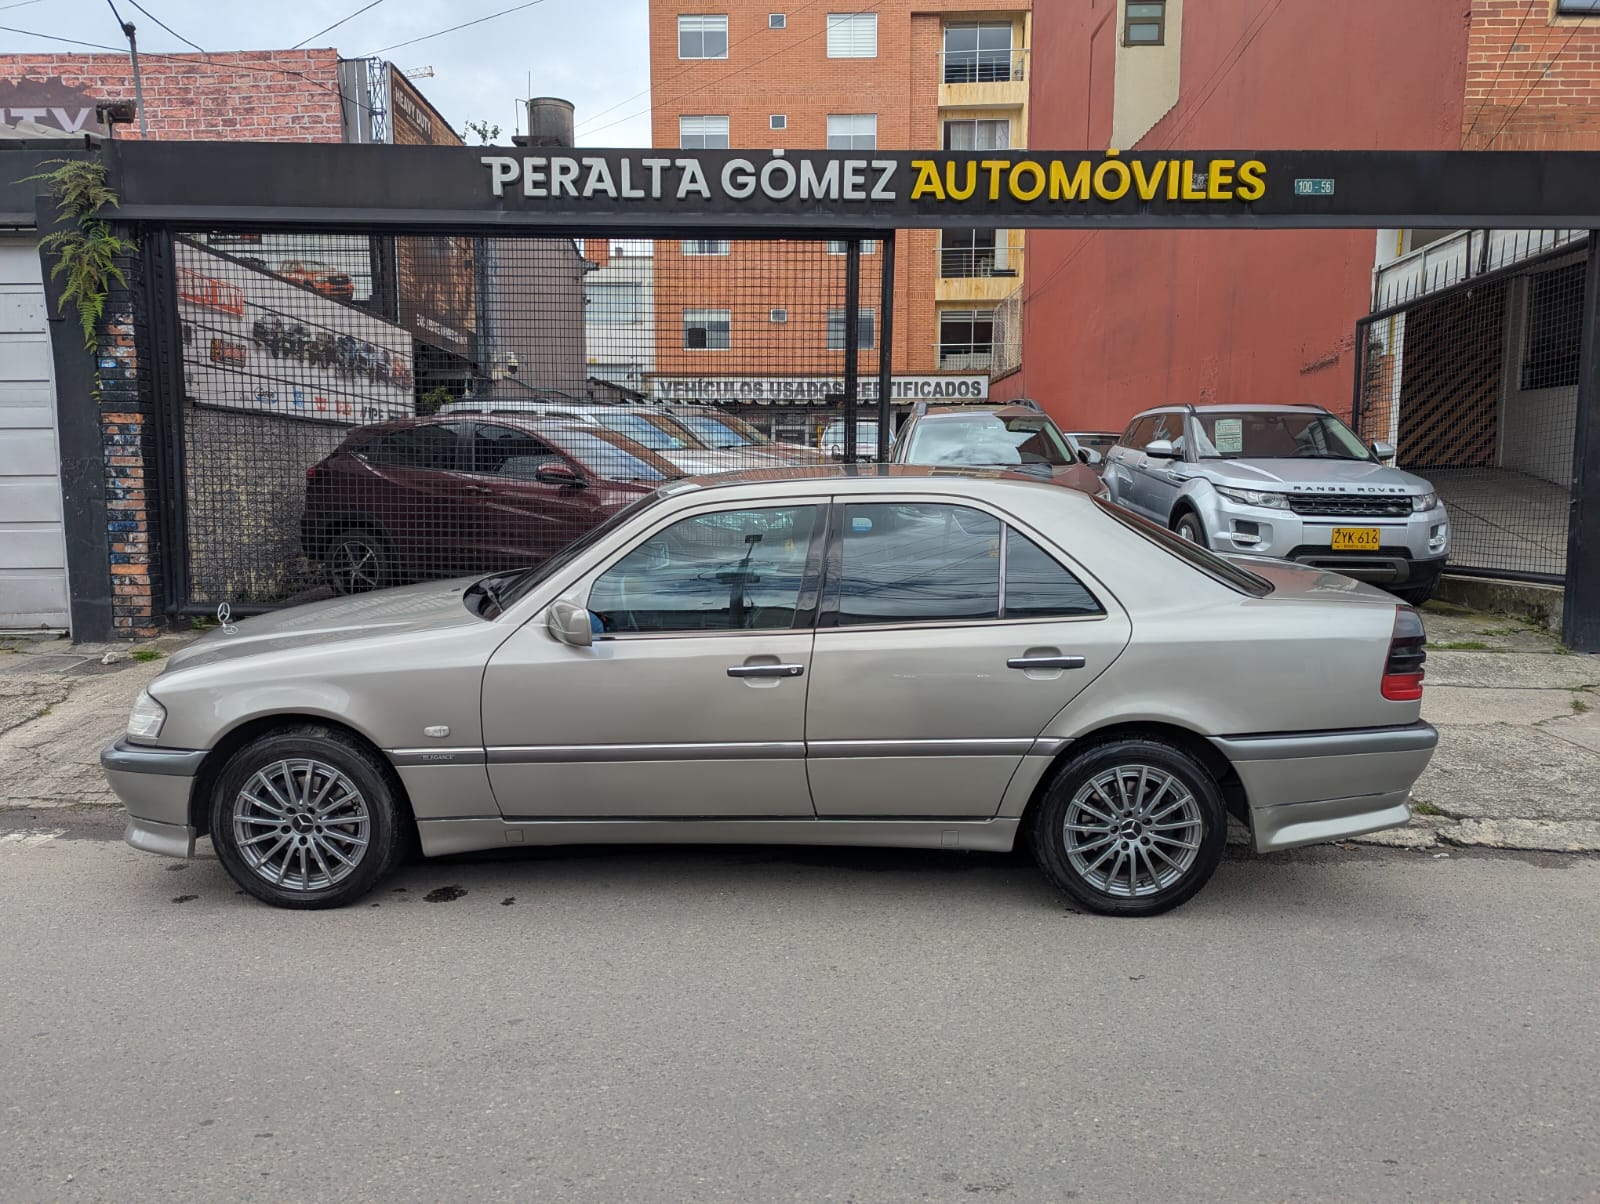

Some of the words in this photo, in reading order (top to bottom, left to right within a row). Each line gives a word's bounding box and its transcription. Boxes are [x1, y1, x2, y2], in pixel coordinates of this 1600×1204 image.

[395, 86, 415, 119] HEAVY
[415, 108, 431, 135] DUTY
[480, 156, 711, 199] PERALTA
[721, 148, 898, 200] GÓMEZ
[911, 148, 1267, 201] AUTOMÓVILES
[1299, 181, 1313, 193] 100
[1321, 181, 1331, 193] 56
[660, 378, 764, 398] VEHÍCULOS
[769, 381, 845, 398] USADOS
[856, 381, 982, 397] ERIFICADOS
[1293, 485, 1347, 493] RANGE
[1357, 531, 1378, 544] 616
